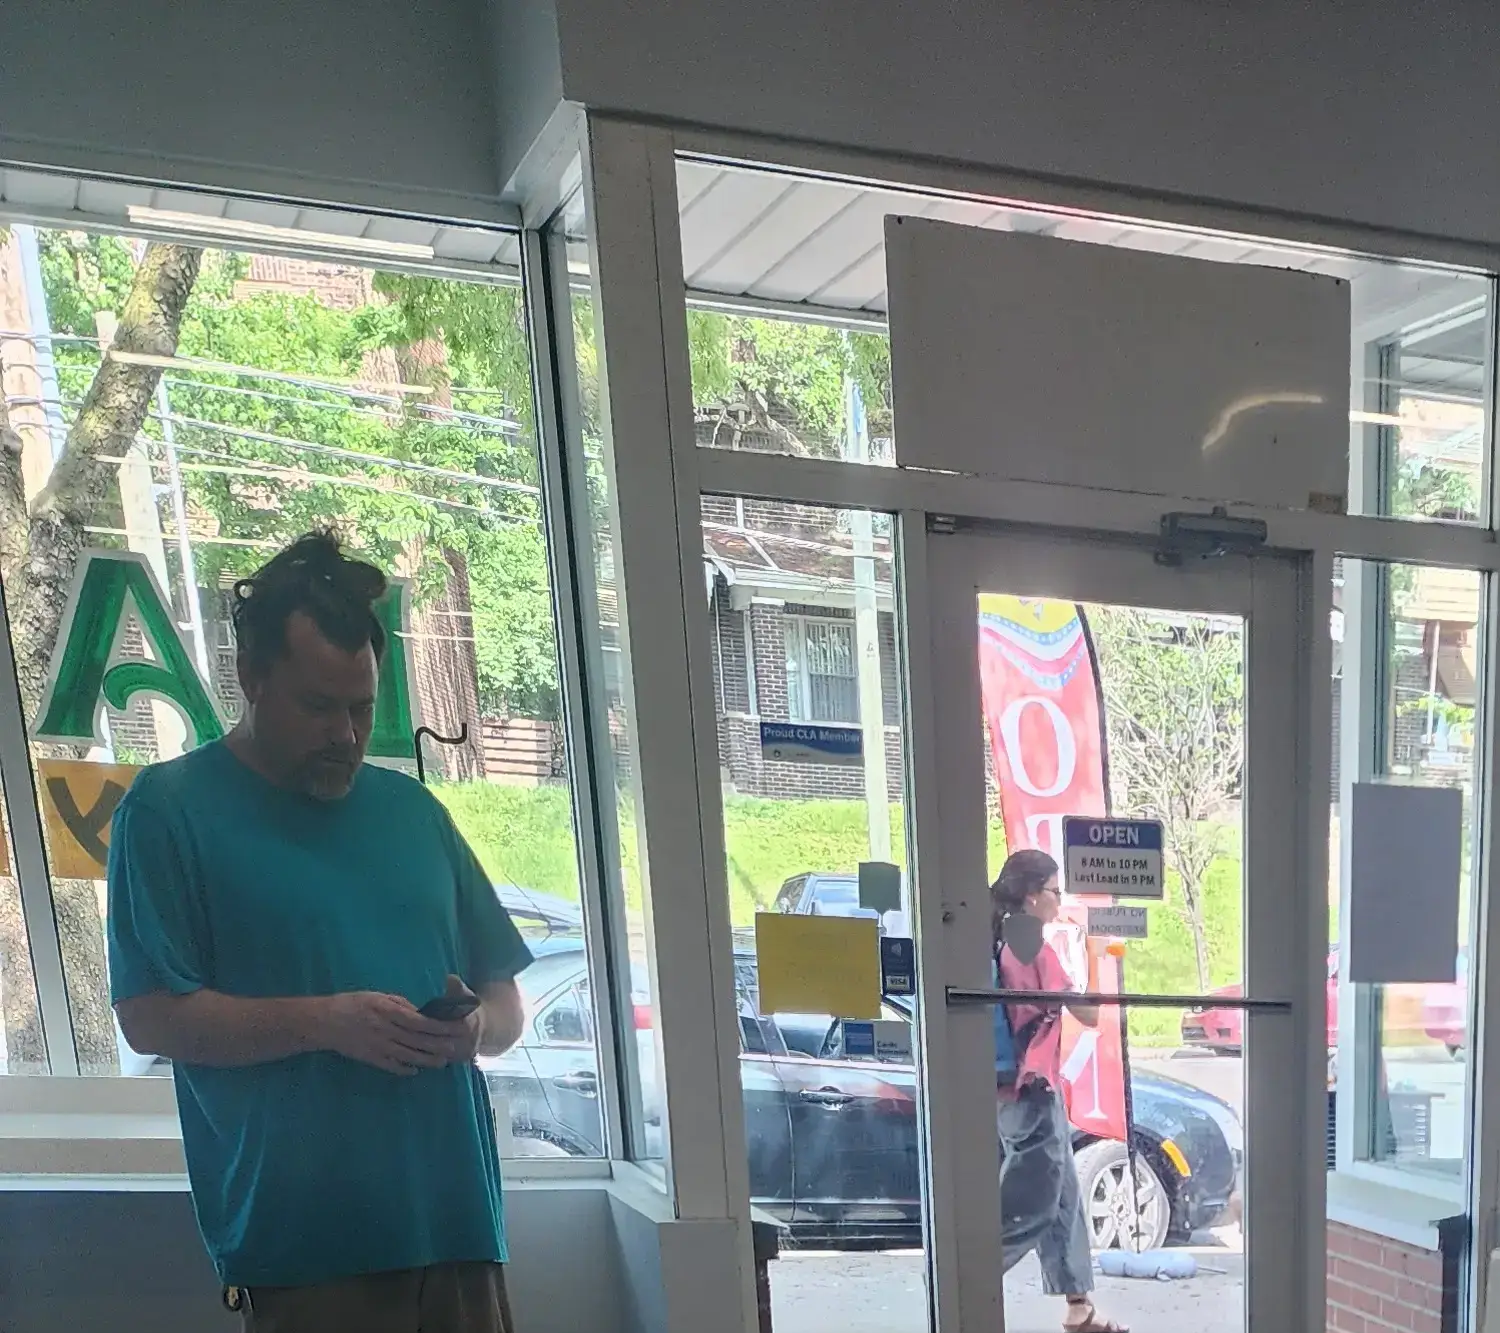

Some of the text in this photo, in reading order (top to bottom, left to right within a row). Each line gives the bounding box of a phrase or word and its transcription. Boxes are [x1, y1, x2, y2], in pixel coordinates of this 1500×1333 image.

[763, 727, 860, 743] Proud CLA Member
[1088, 825, 1140, 846] OPEN
[1081, 857, 1148, 871] 8 AM to 10 PM
[1140, 875, 1156, 886] PM
